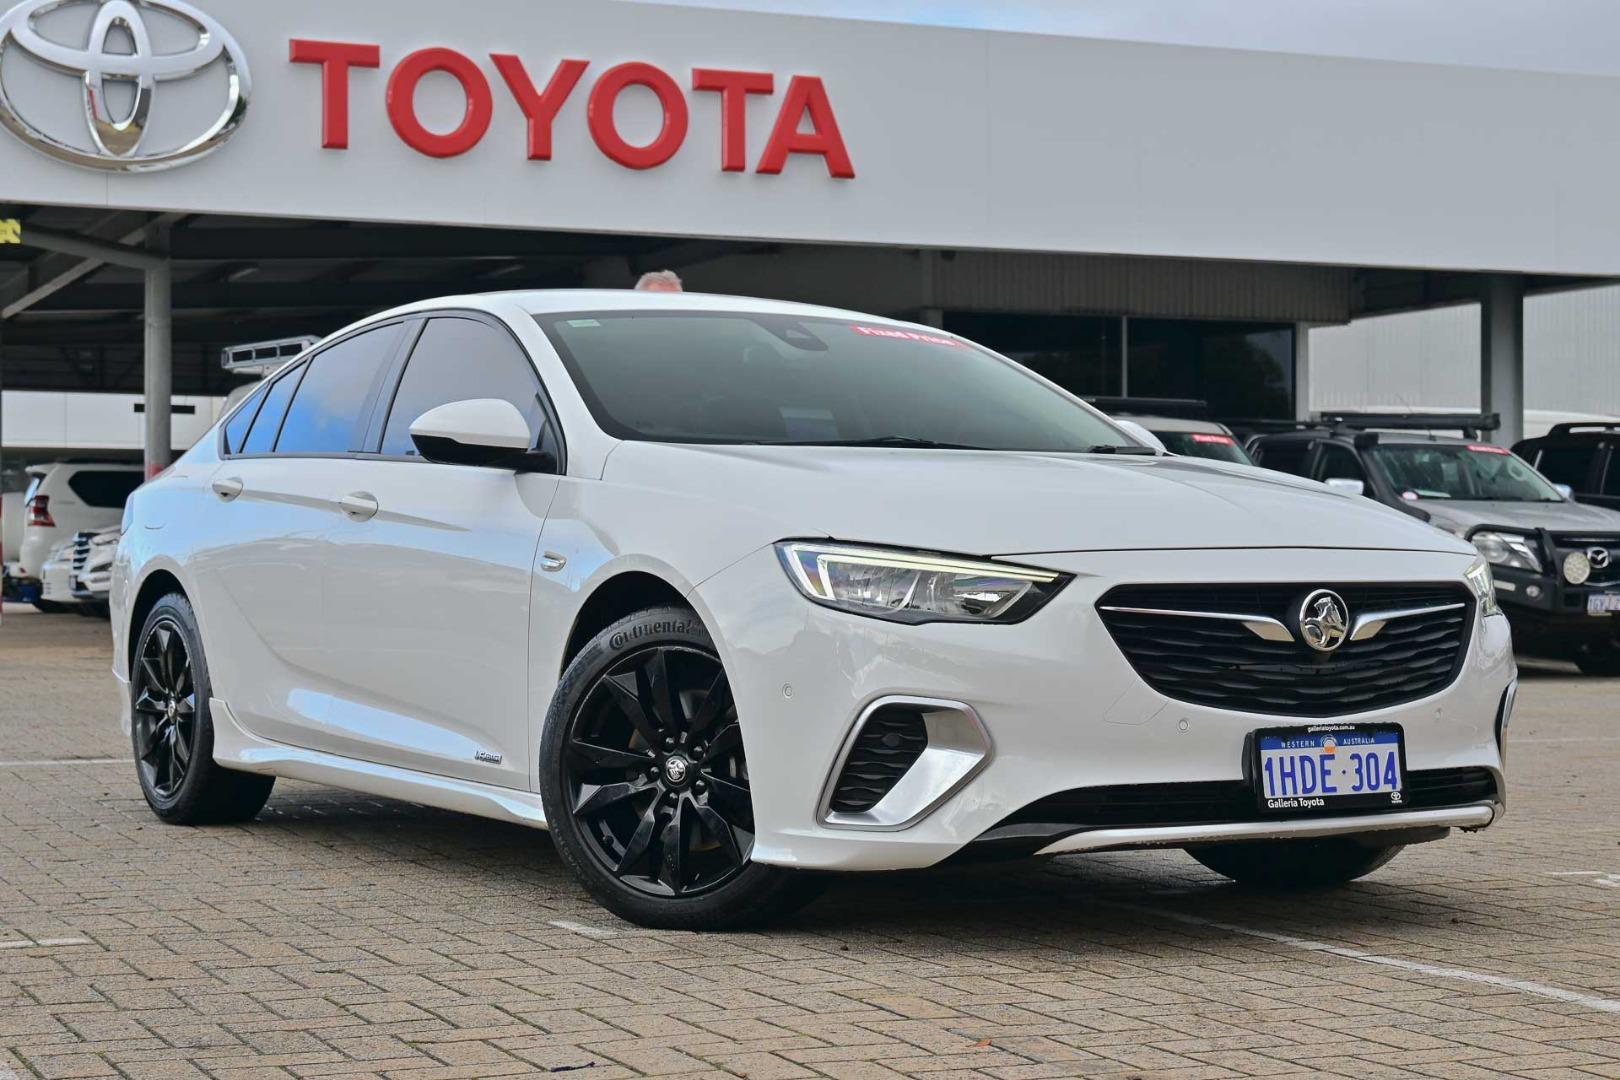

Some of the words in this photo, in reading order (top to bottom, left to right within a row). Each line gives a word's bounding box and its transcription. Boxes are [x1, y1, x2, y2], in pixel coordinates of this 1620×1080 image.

[289, 38, 856, 179] TOYOTA
[609, 619, 692, 650] Continental
[1281, 740, 1315, 749] WESTERN
[1343, 737, 1375, 745] AUSTRALIA
[1264, 754, 1338, 797] 1HDE
[1350, 751, 1398, 792] 304
[1267, 797, 1298, 809] Galleria
[1299, 798, 1325, 809] Toyota
